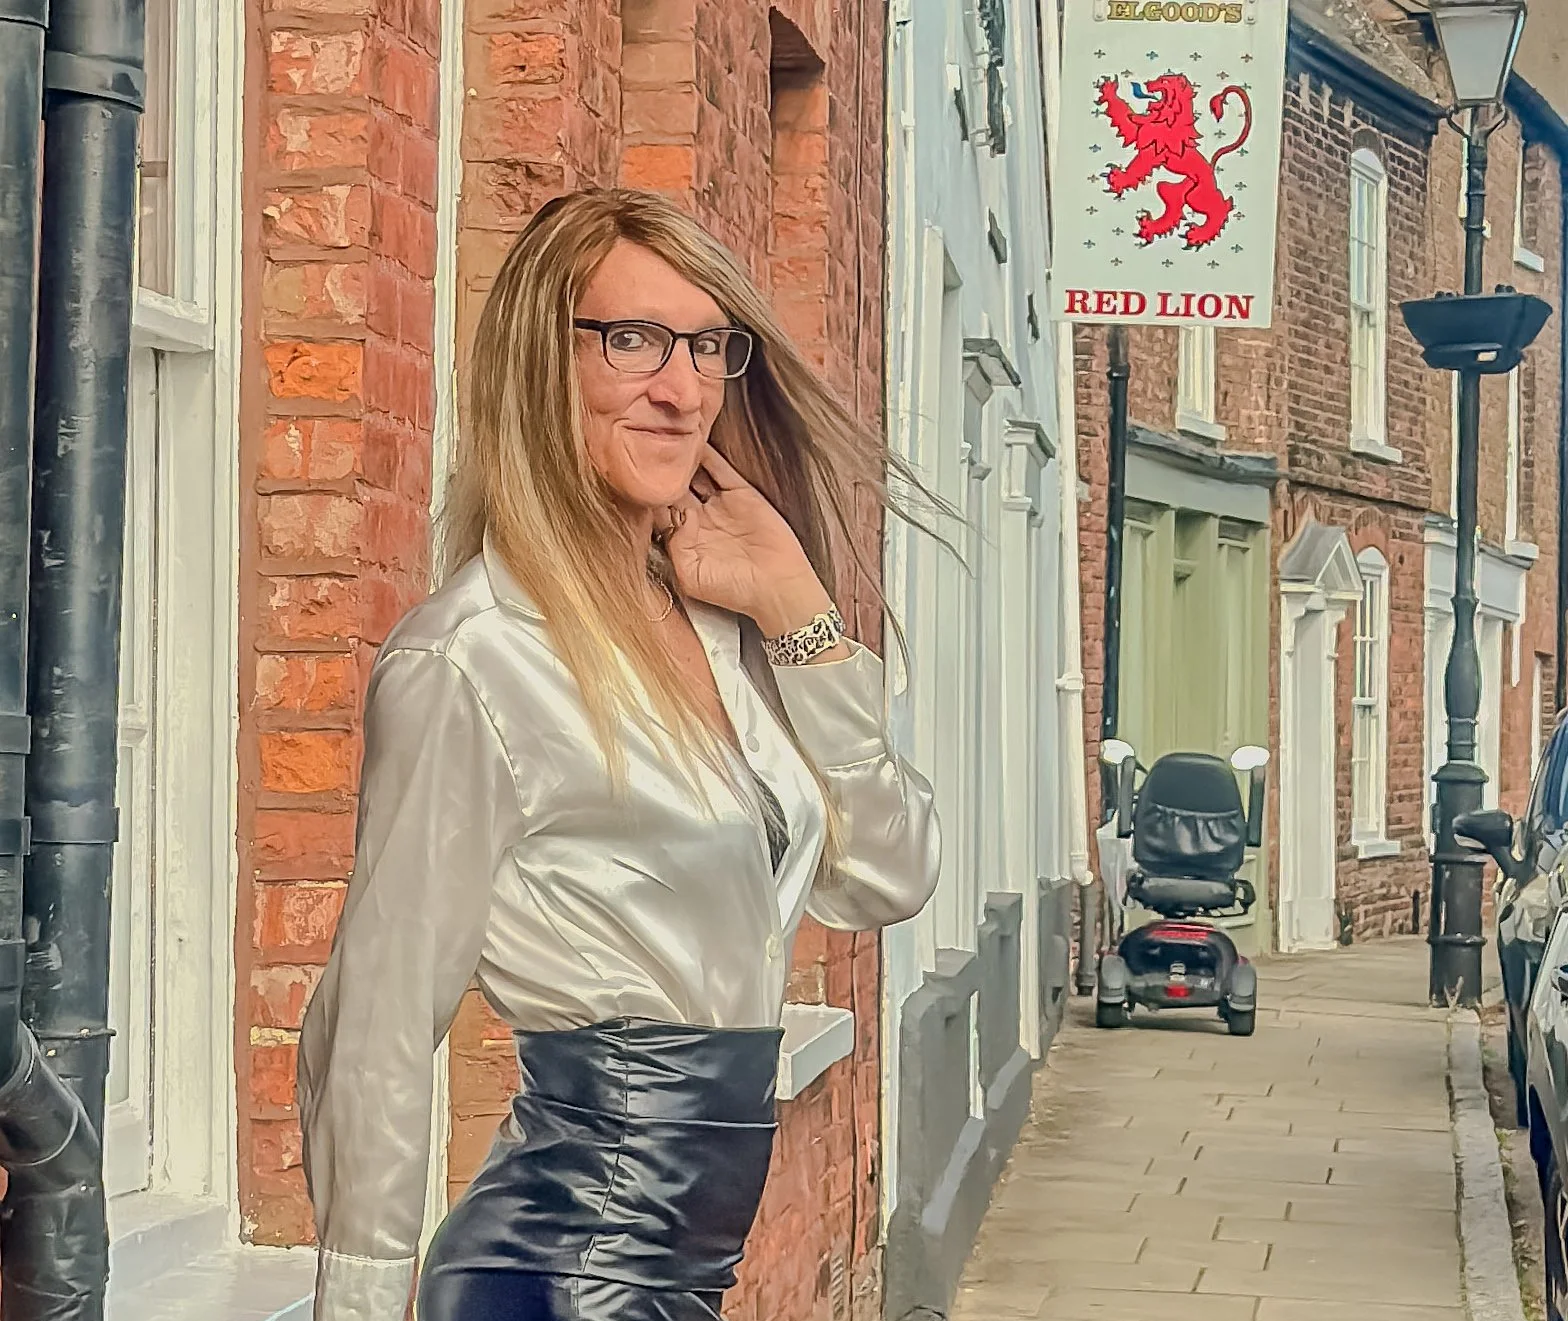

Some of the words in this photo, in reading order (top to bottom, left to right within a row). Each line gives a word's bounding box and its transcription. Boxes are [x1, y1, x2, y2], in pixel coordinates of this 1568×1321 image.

[1107, 1, 1242, 23] ELGOOD'S
[1064, 289, 1147, 315] RED
[1155, 292, 1255, 319] LION
